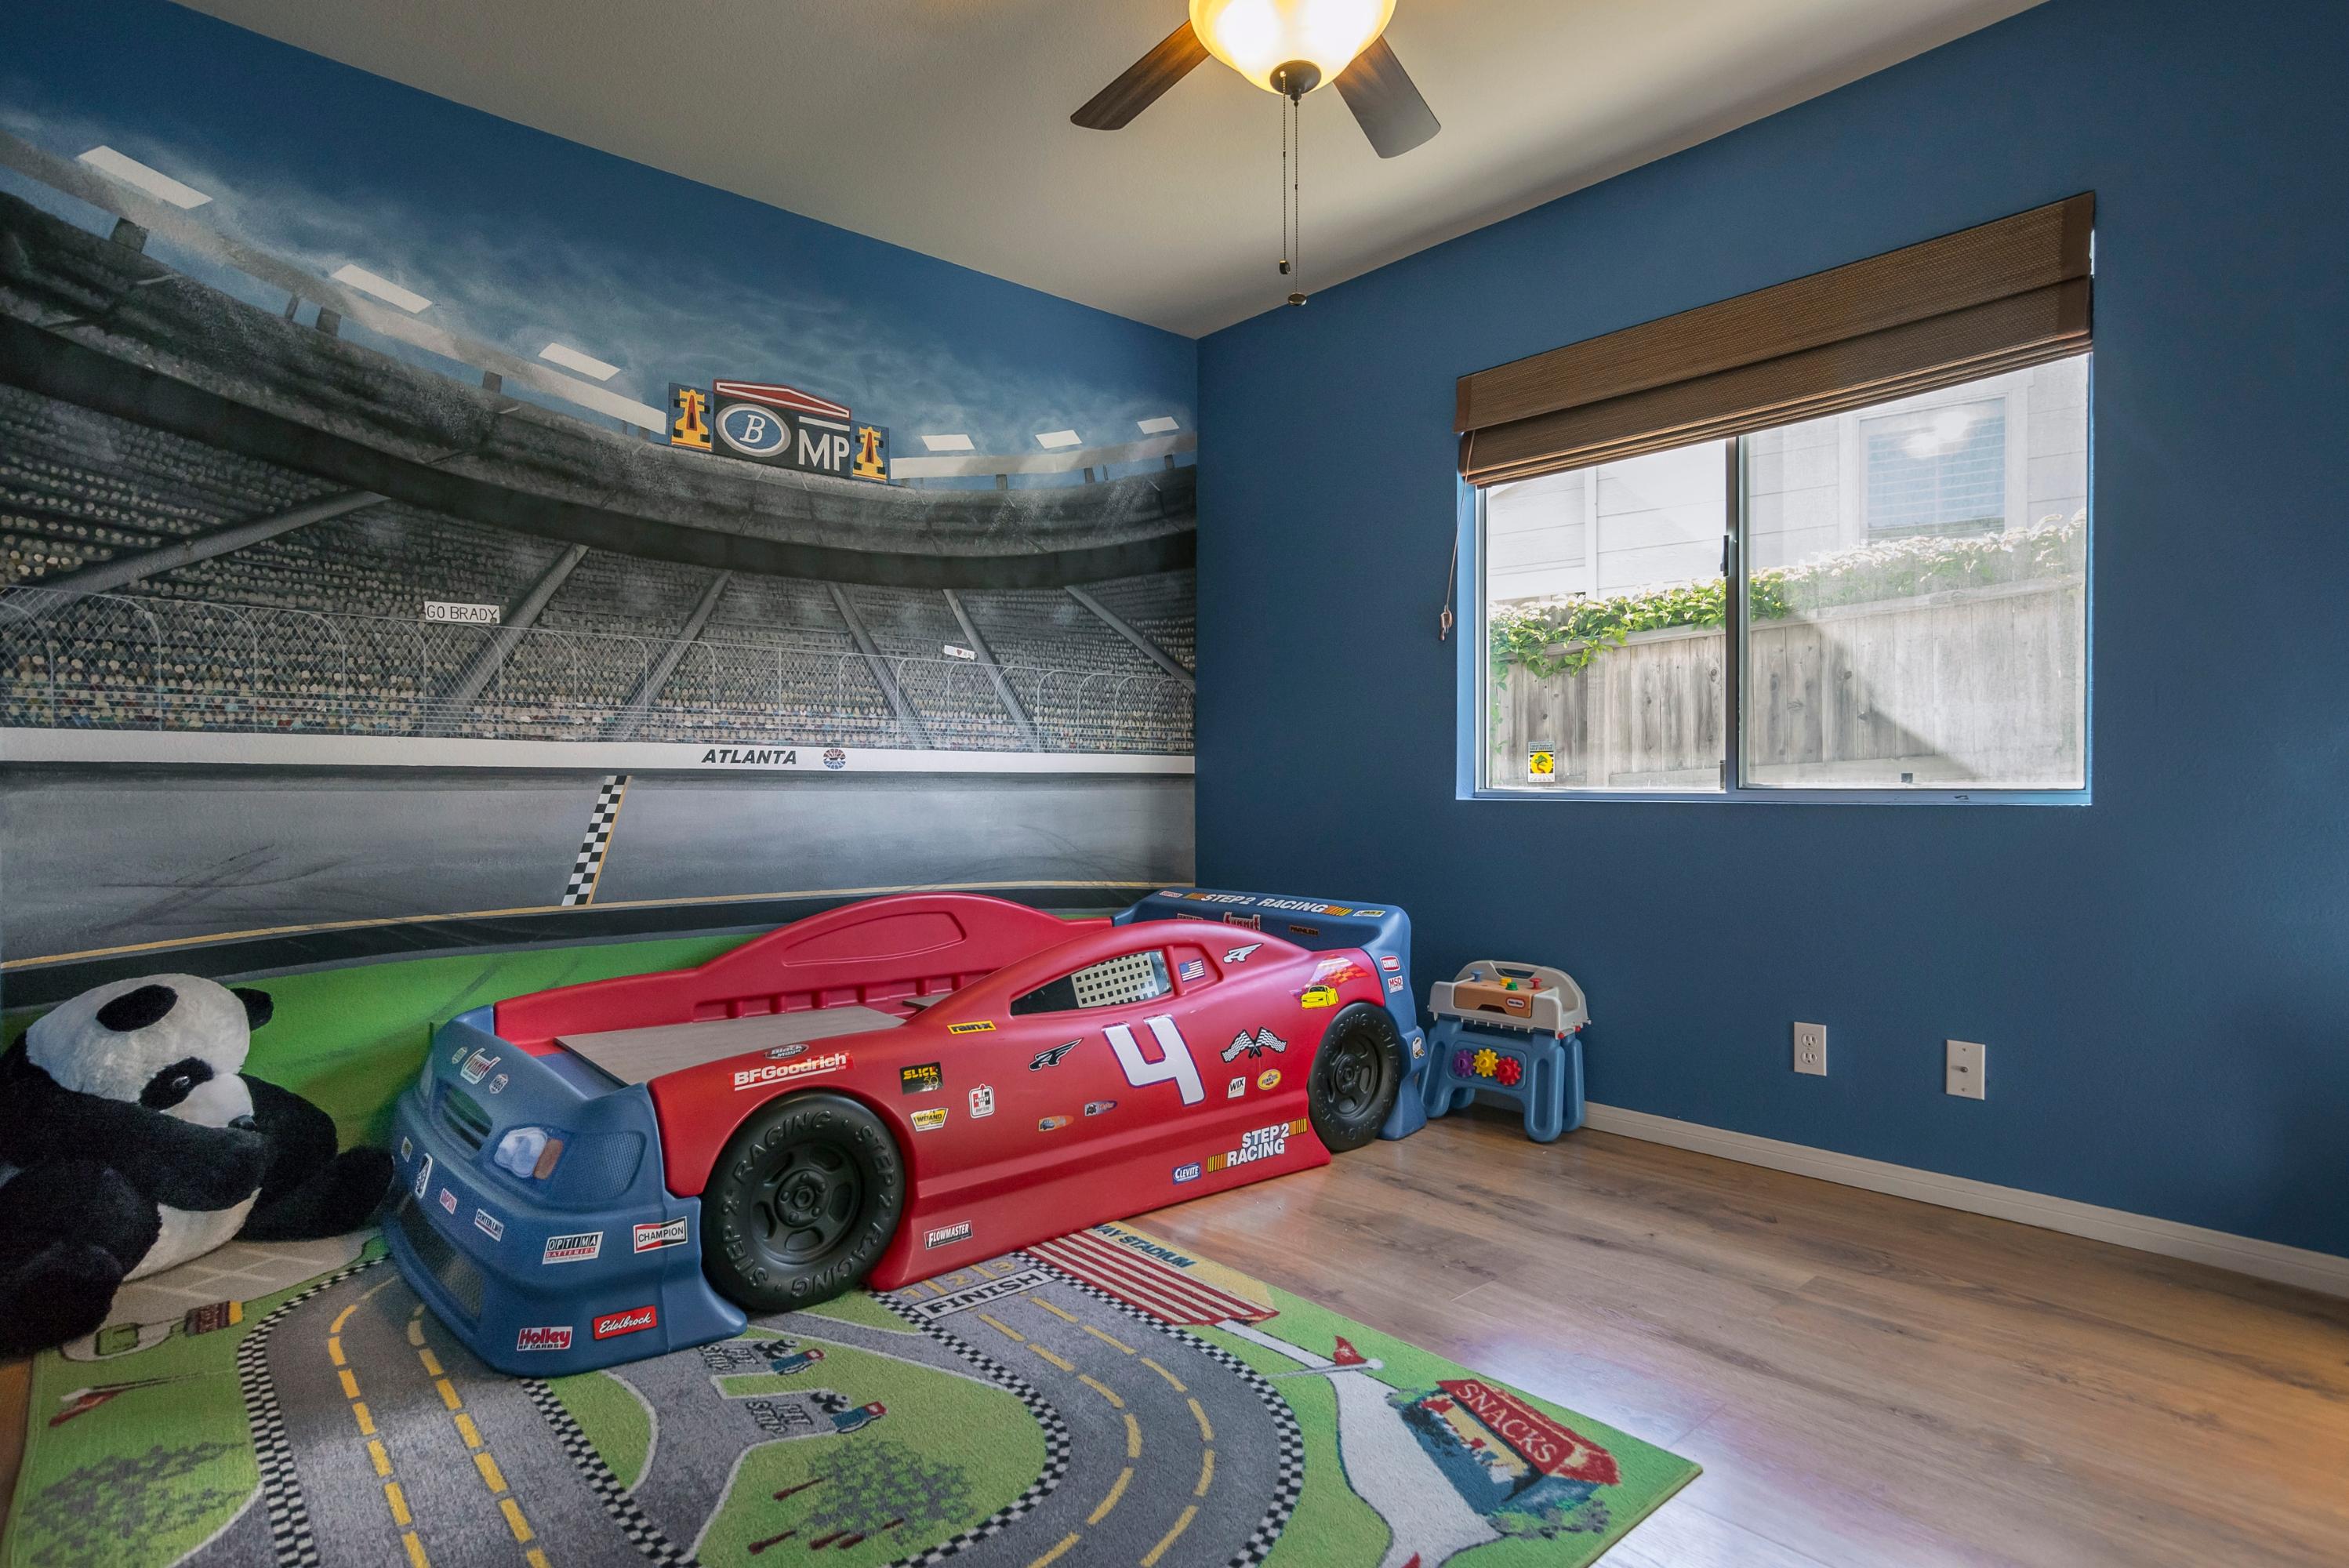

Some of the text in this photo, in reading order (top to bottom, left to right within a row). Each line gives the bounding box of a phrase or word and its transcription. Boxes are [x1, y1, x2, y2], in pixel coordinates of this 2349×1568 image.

[739, 414, 766, 444] B
[798, 428, 850, 471] MP
[427, 604, 497, 621] GO BRADY
[701, 749, 797, 764] ATLANTA
[1256, 898, 1329, 913] RACING
[1389, 977, 1402, 986] MSD
[734, 1053, 847, 1086] BFGoodrich
[1101, 1013, 1206, 1107] 4
[924, 1076, 939, 1086] 50
[1229, 1078, 1244, 1091] WIX
[1241, 1123, 1290, 1149] STEP 2
[733, 1110, 831, 1185] RACING
[1226, 1139, 1285, 1167] RACING
[1174, 1164, 1200, 1179] CLEVITE
[548, 1236, 597, 1250] OPTIMA
[638, 1226, 684, 1243] CHAMPION
[928, 1223, 969, 1247] FLOWMASTER
[546, 1247, 596, 1258] BATTERIES
[1118, 1236, 1198, 1268] STADIUM
[991, 1261, 1016, 1272] 3
[924, 1273, 1044, 1314] FINISH
[598, 1312, 652, 1334] Edelbrock
[519, 1327, 572, 1348] Holley
[1456, 1383, 1557, 1463] SNACKS
